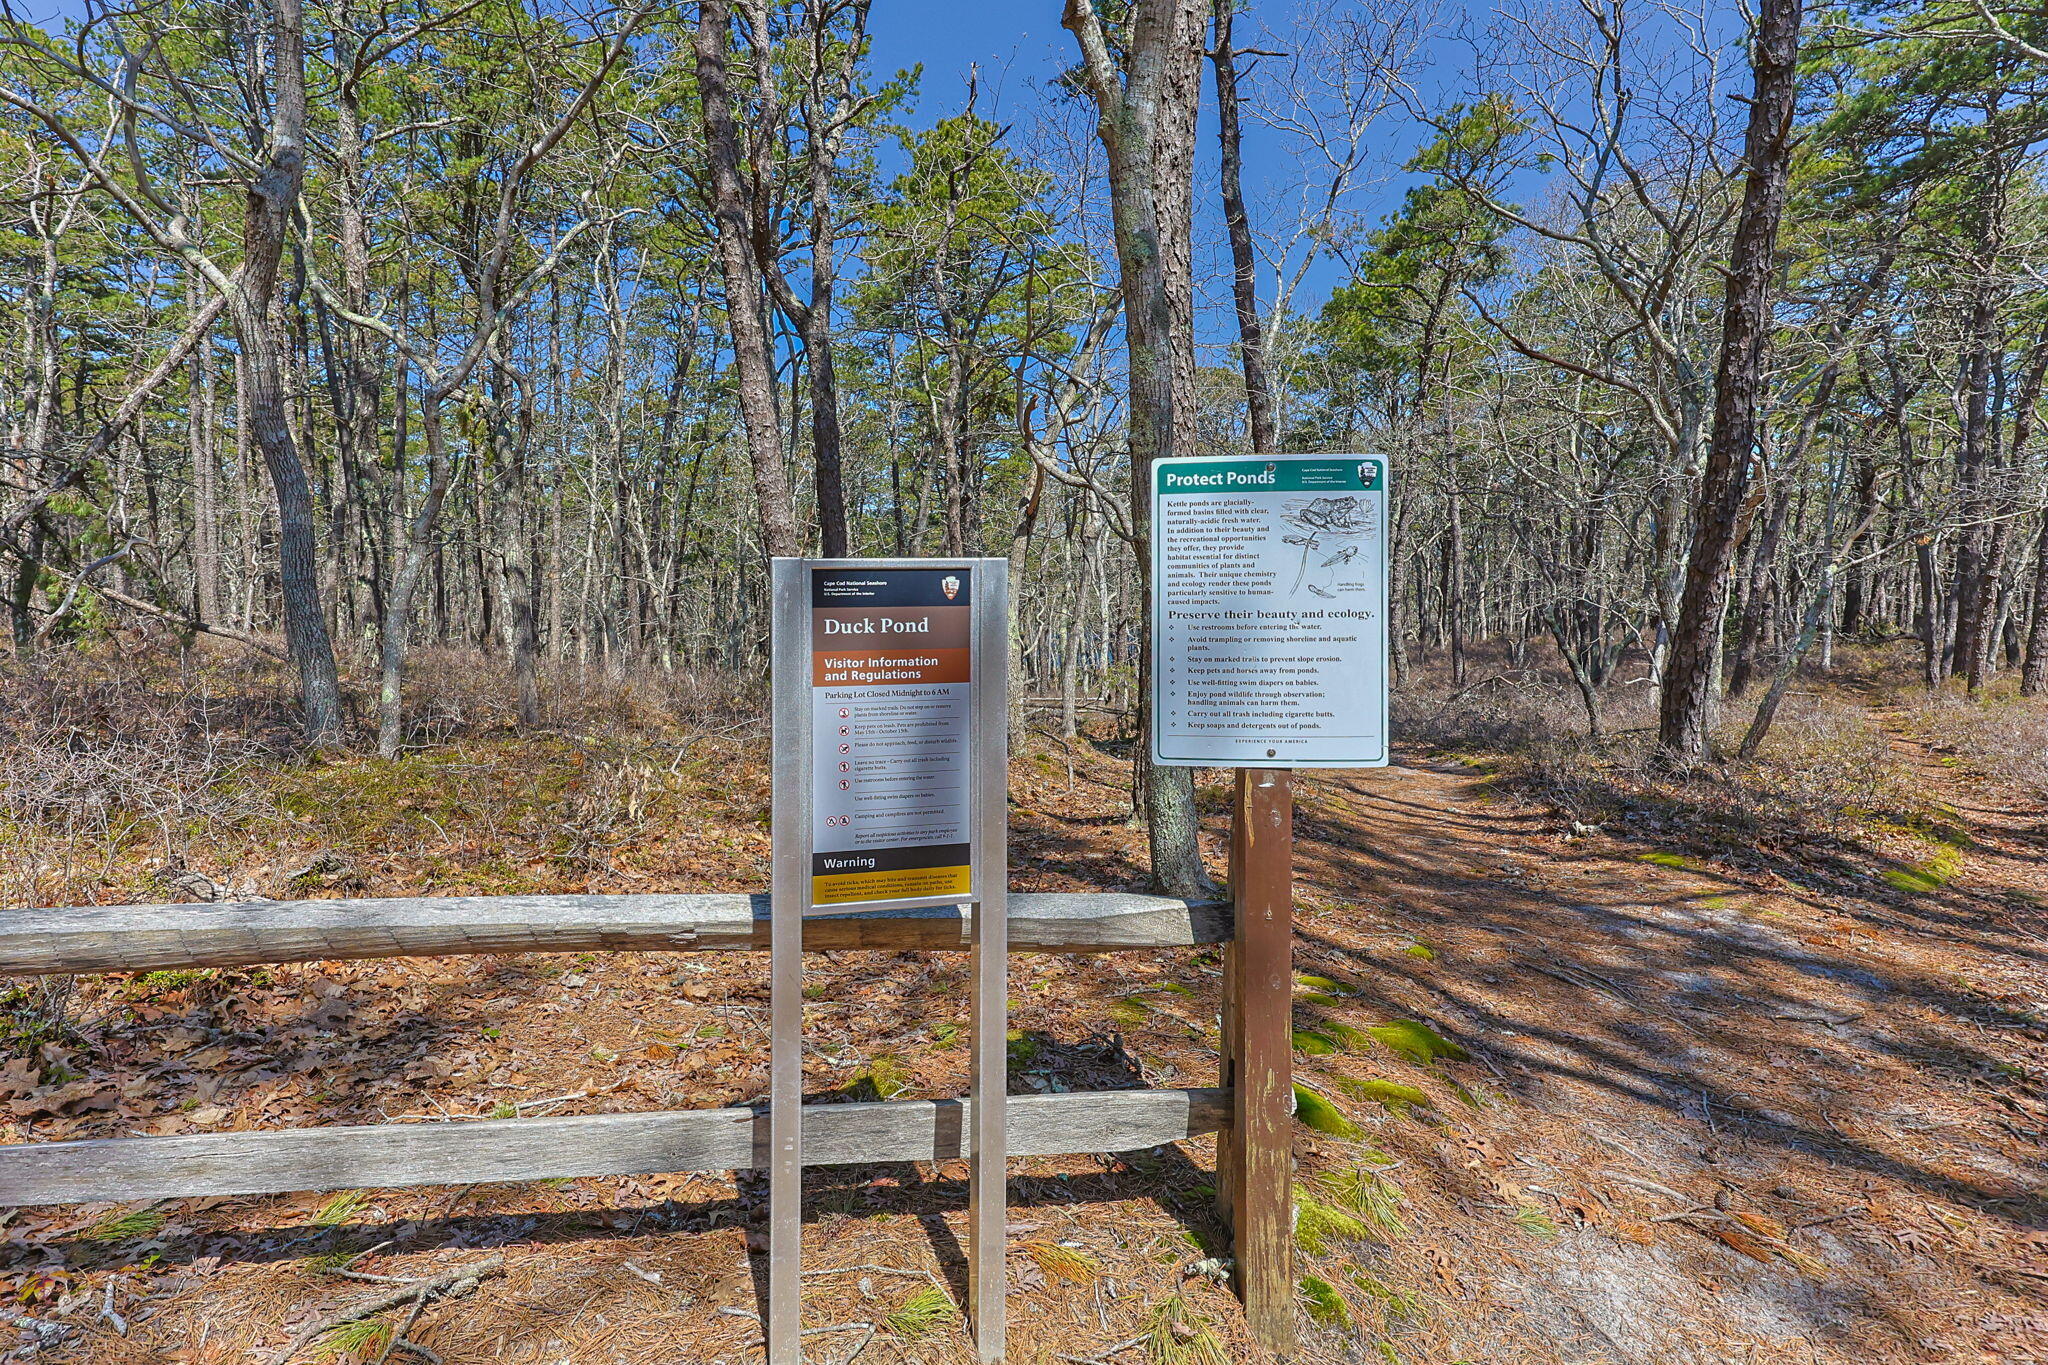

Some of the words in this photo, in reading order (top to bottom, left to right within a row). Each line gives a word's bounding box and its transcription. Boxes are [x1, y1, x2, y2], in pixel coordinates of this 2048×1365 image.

[1167, 473, 1223, 486] Protect
[1227, 470, 1275, 485] Ponds
[1189, 500, 1209, 508] ponds
[1223, 499, 1254, 507] glacially-
[1167, 518, 1220, 526] naturally-acidic
[1232, 526, 1255, 534] beauty
[1220, 534, 1266, 543] opportunities
[1218, 544, 1245, 552] provide
[1167, 590, 1207, 598] particularly
[1169, 611, 1220, 619] Preserve
[1224, 610, 1253, 619] their
[1257, 610, 1297, 621] beauty
[1302, 609, 1324, 618] and
[1328, 609, 1374, 620] ecology.
[824, 618, 875, 634] Duck
[880, 617, 929, 633] Pond
[1187, 635, 1207, 643] Avoid
[1208, 635, 1243, 644] trampling
[824, 657, 865, 669] Visitor
[868, 656, 938, 667] Information
[1187, 656, 1204, 664] Stay
[1187, 667, 1206, 675] Keep
[825, 670, 847, 681] and
[851, 669, 921, 683] Regulations
[825, 692, 853, 700] Parking
[891, 689, 923, 698] Midnight
[1188, 690, 1208, 699] Enjoy
[1209, 691, 1227, 699] pond
[1187, 698, 1218, 707] handling
[1187, 710, 1208, 719] Carry
[1187, 721, 1206, 730] Keep
[824, 856, 875, 869] Warning
